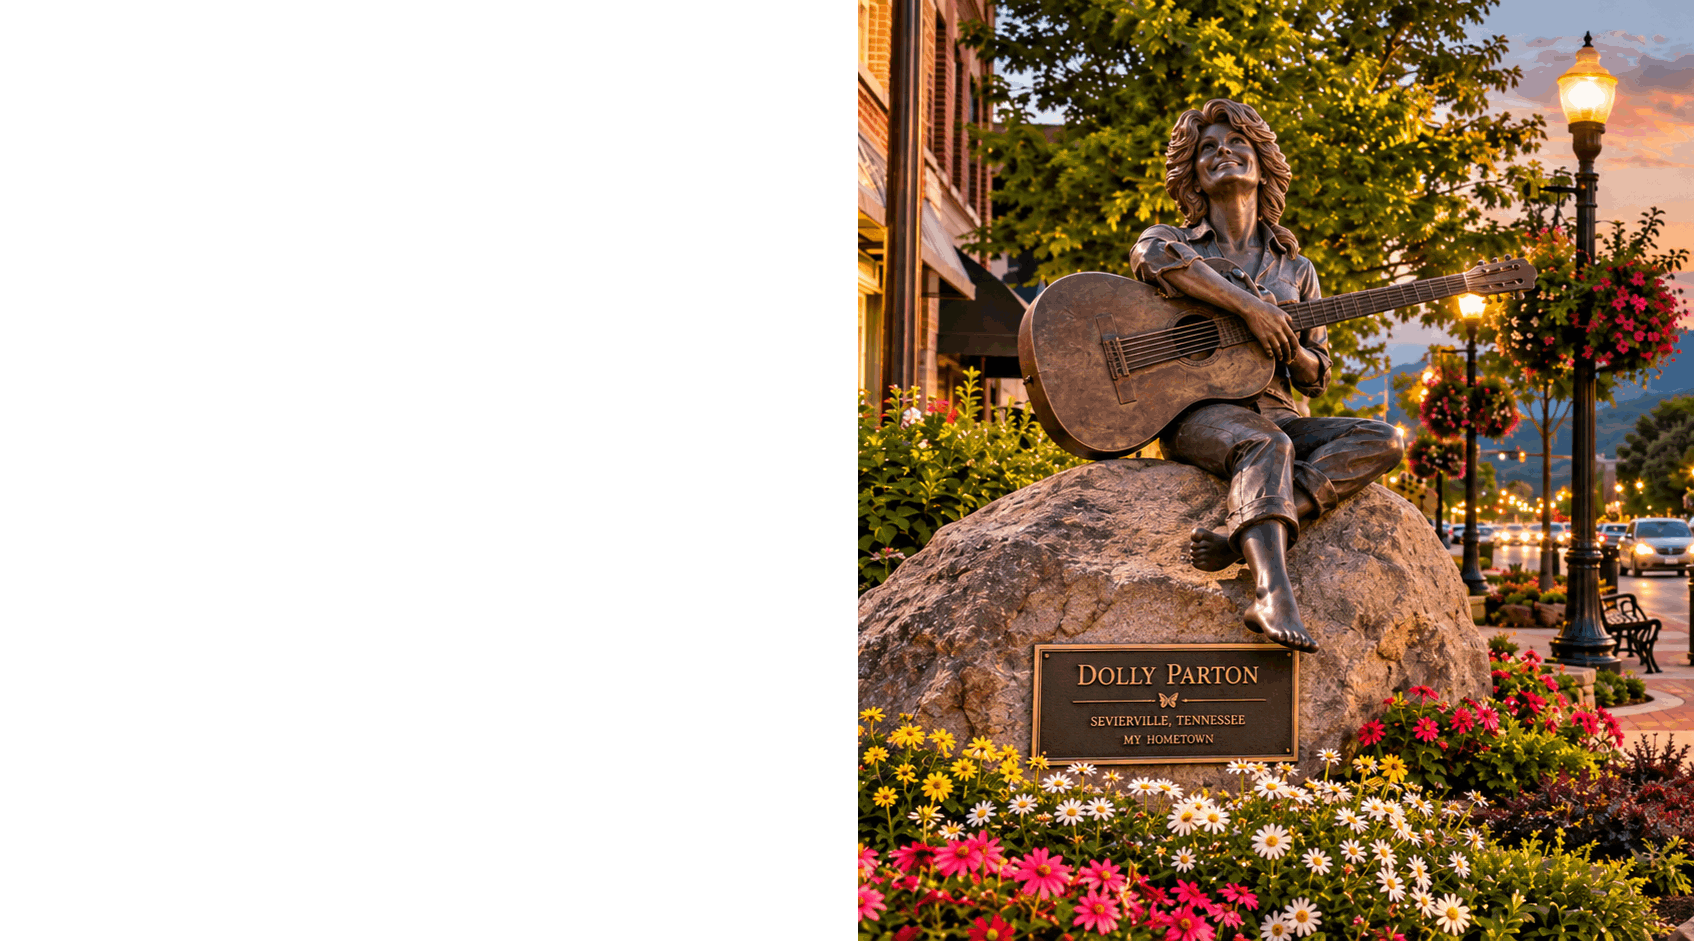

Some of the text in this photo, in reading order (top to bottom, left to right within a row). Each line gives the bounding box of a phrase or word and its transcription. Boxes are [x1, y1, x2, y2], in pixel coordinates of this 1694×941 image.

[1077, 663, 1260, 686] DOLLY PARTON
[1090, 714, 1246, 728] SEVIERVILLE, TENNESSEE
[1123, 734, 1215, 746] MY HOMETOWN
